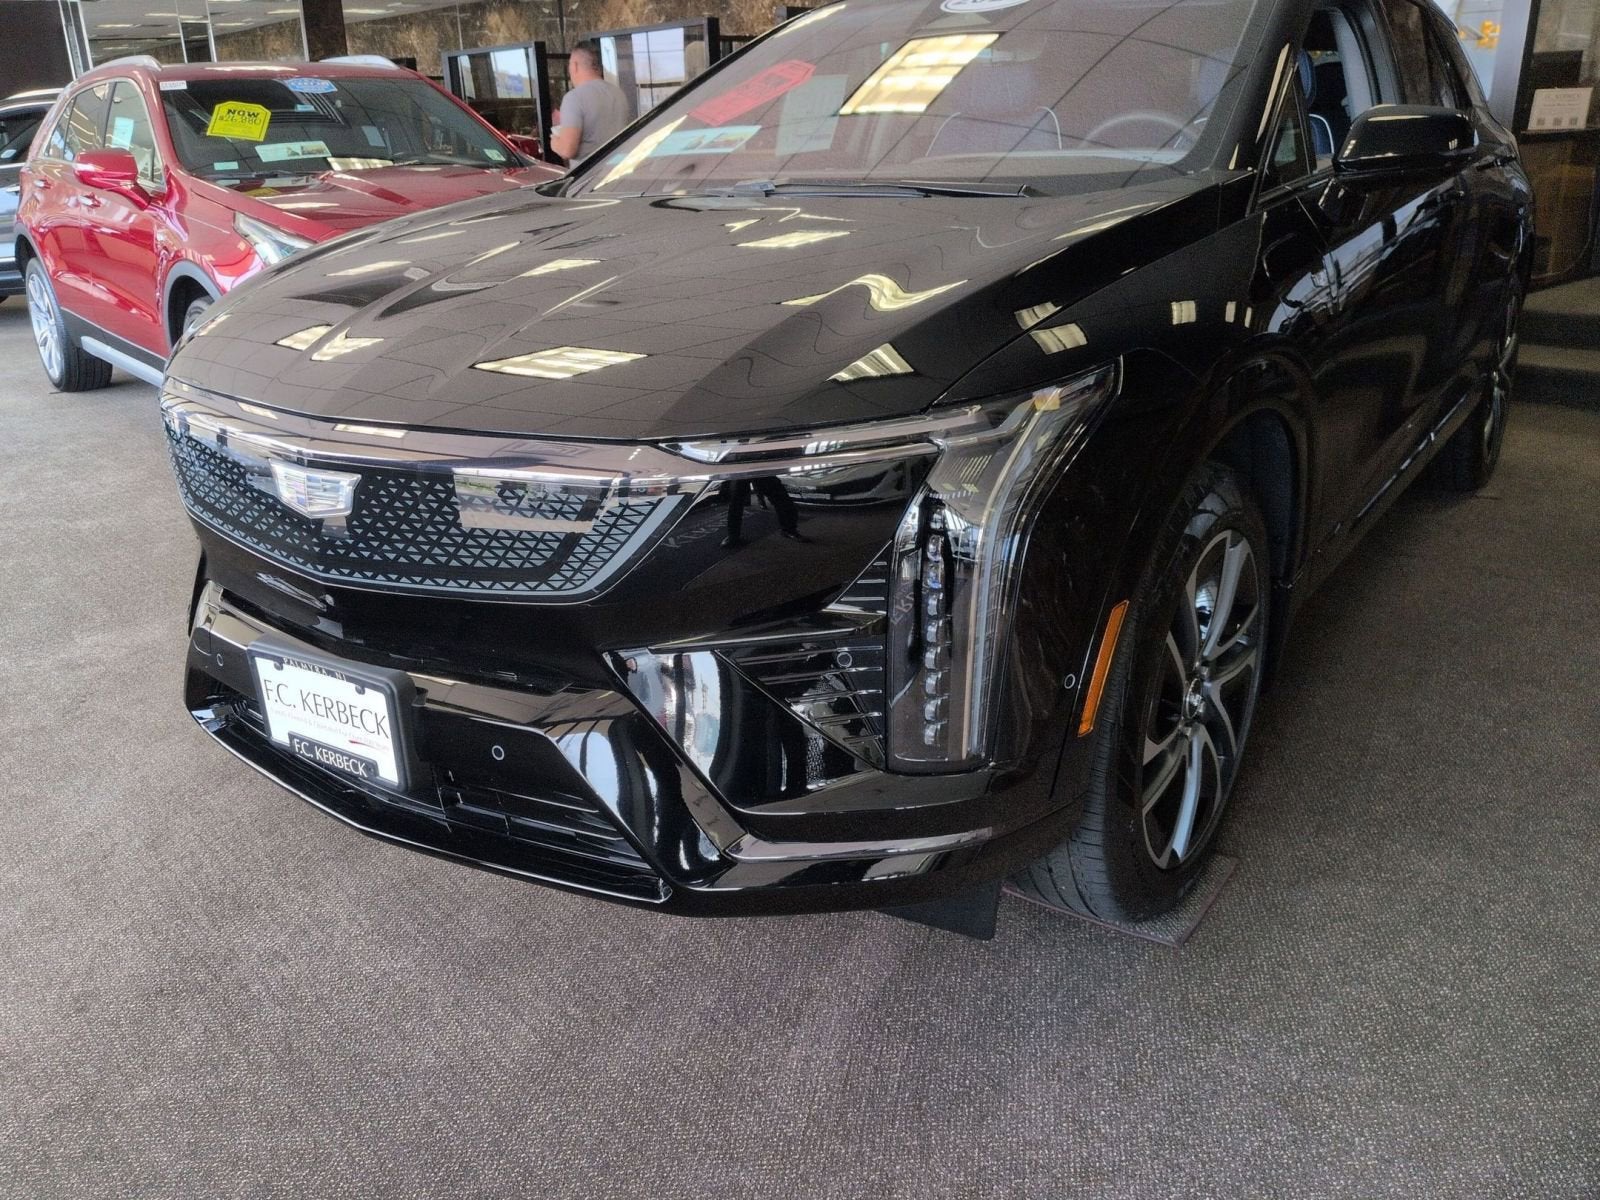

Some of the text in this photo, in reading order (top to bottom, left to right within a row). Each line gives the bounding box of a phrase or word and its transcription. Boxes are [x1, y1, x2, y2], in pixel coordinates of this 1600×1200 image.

[227, 109, 260, 118] NOW
[263, 679, 296, 709] F.C.
[300, 689, 389, 739] KERBECK
[294, 738, 368, 778] F.C. KERBECK
